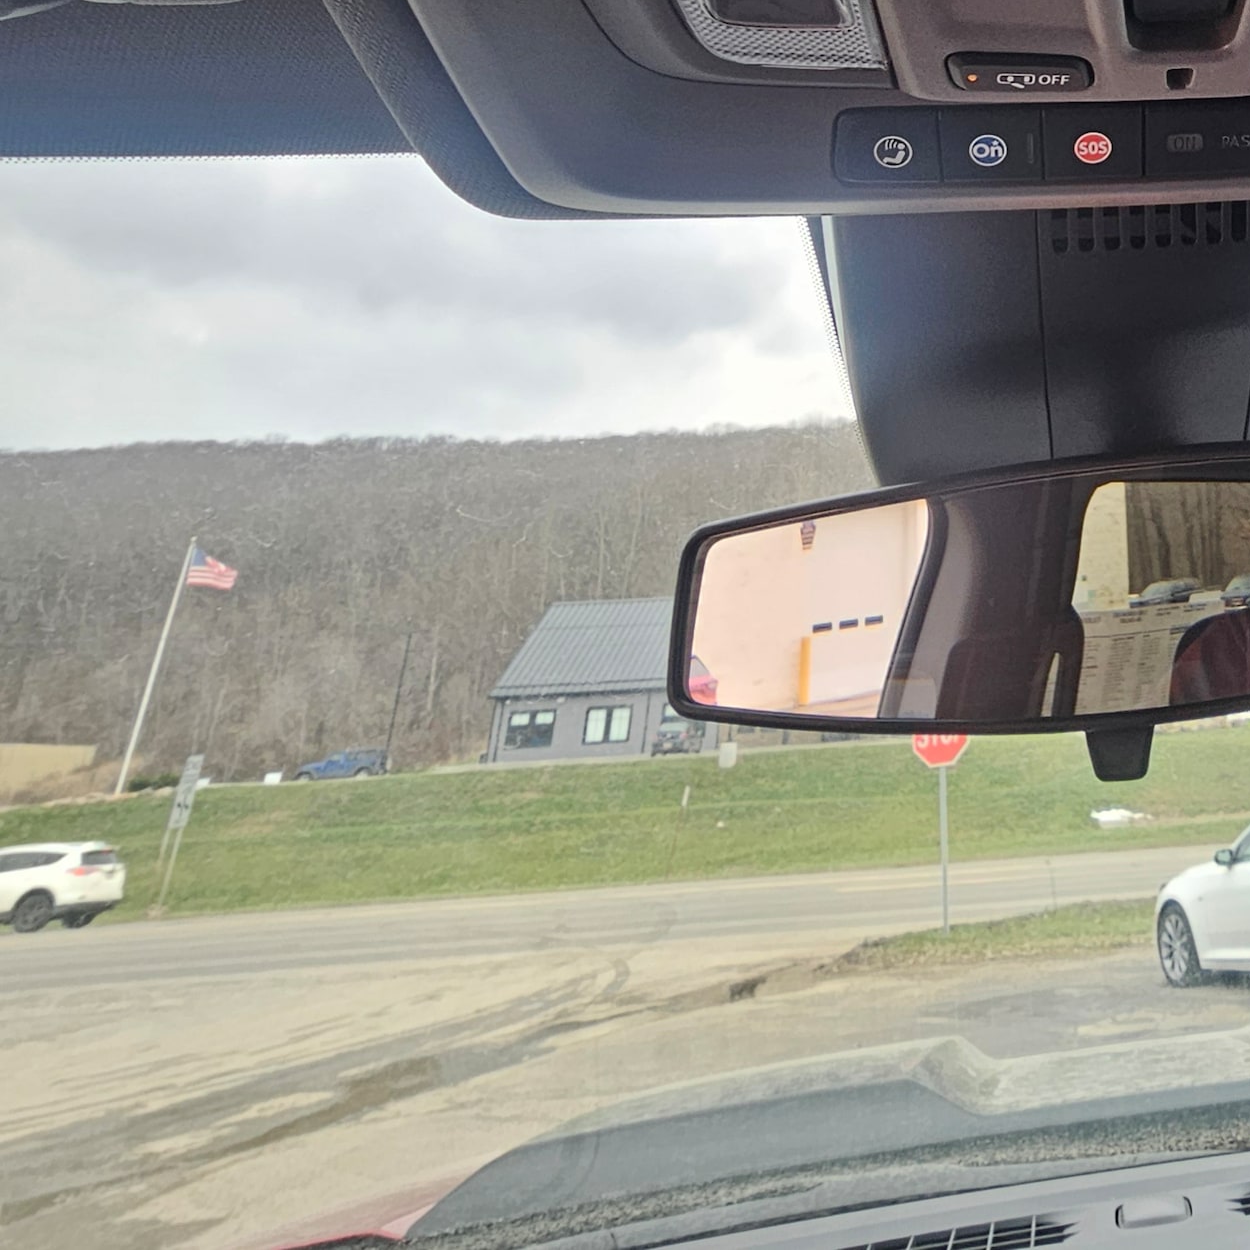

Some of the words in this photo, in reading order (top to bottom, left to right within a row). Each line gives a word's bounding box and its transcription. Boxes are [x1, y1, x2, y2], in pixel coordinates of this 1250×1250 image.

[1038, 74, 1070, 85] OFF
[971, 140, 1003, 158] On
[1078, 141, 1107, 155] SOS
